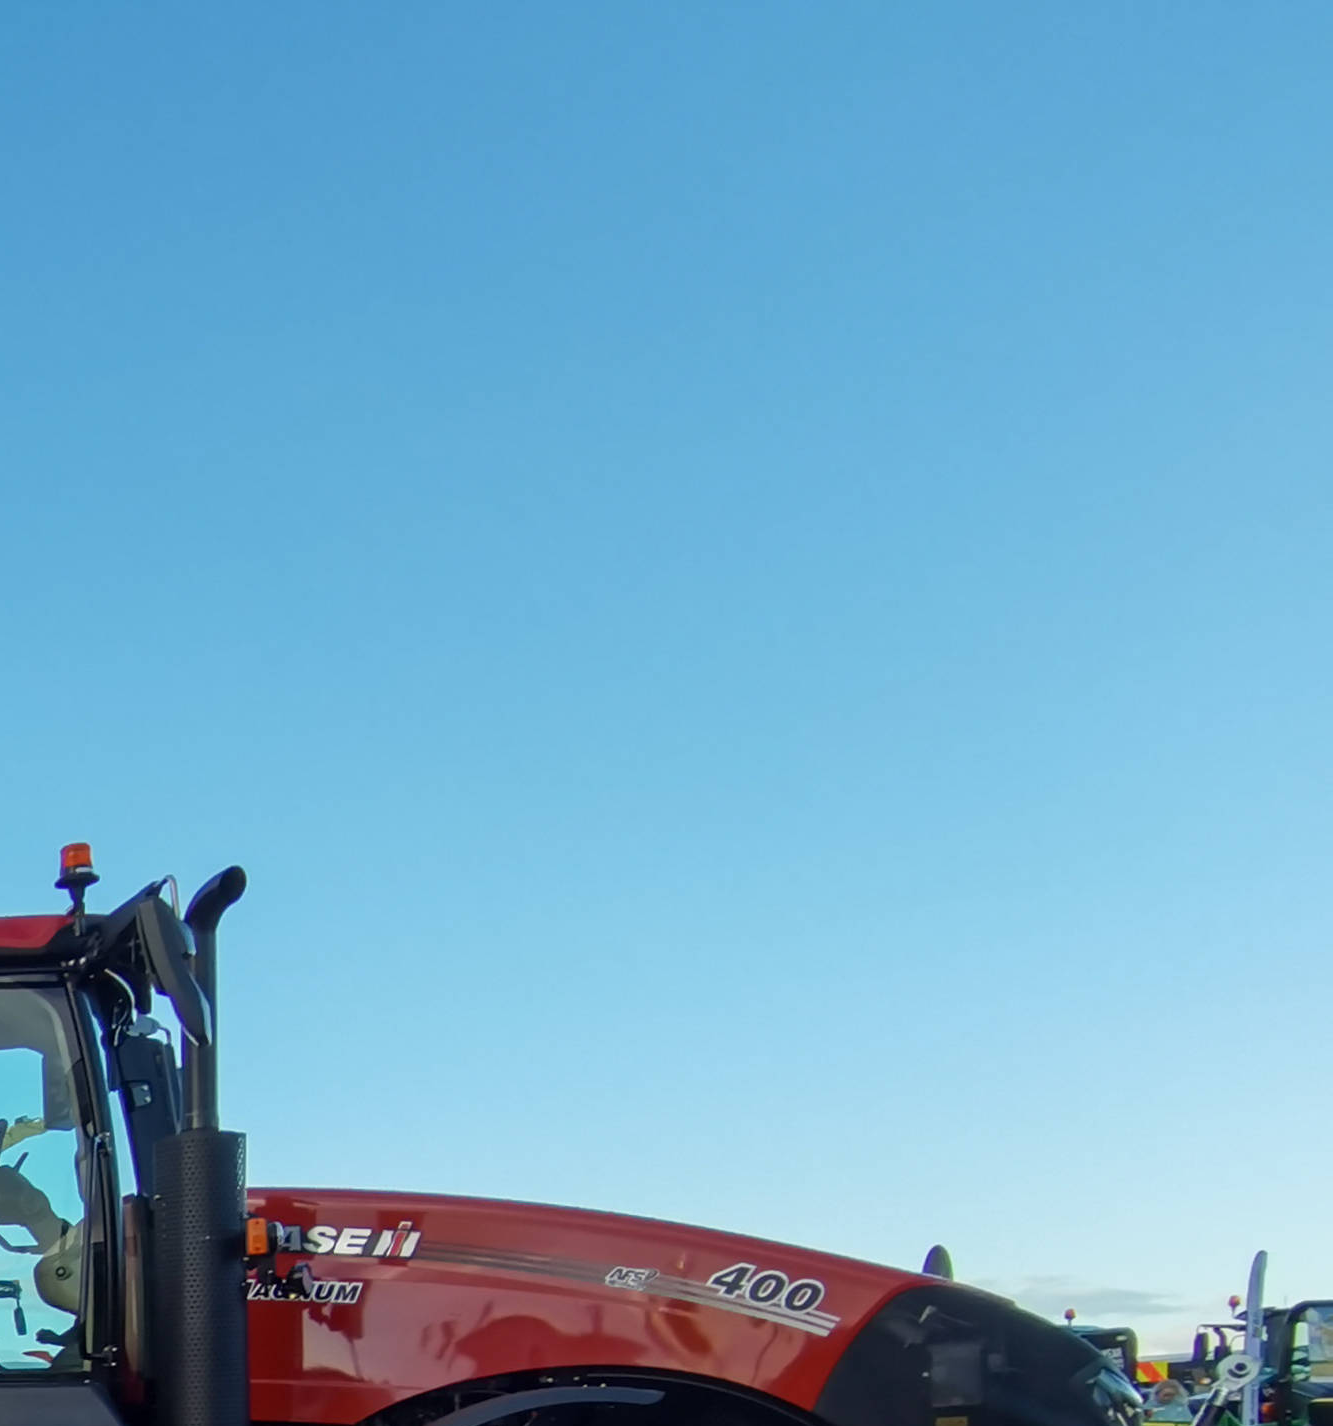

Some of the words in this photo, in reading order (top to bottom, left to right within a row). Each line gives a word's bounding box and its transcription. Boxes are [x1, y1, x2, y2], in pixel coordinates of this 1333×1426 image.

[278, 1225, 372, 1254] ASE
[246, 1279, 363, 1304] AGUM
[706, 1262, 825, 1315] 400
